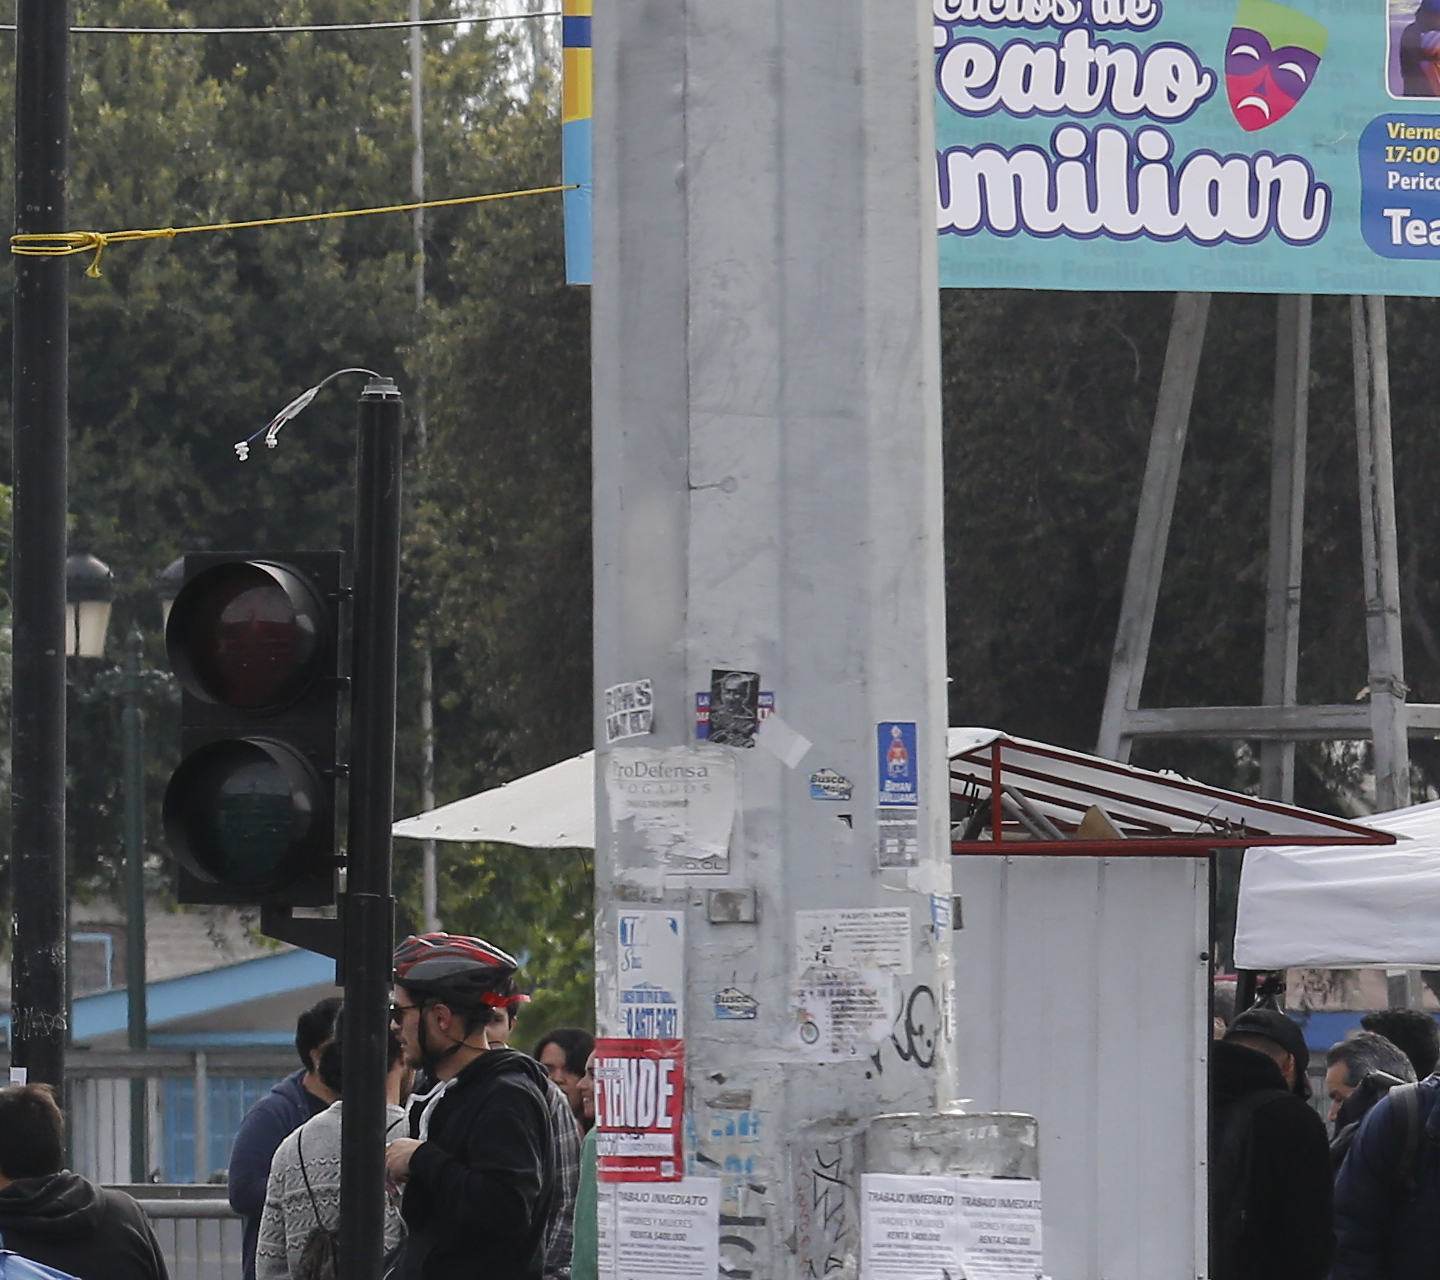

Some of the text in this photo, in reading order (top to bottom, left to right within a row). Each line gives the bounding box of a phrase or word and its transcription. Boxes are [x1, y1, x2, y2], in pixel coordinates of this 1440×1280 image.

[933, 26, 1213, 117] eatro
[937, 126, 1327, 240] miliar
[867, 1191, 955, 1207] TRABAJO INMEDIATO
[961, 1196, 997, 1208] TRABAJO
[886, 1231, 910, 1240] RENTA
